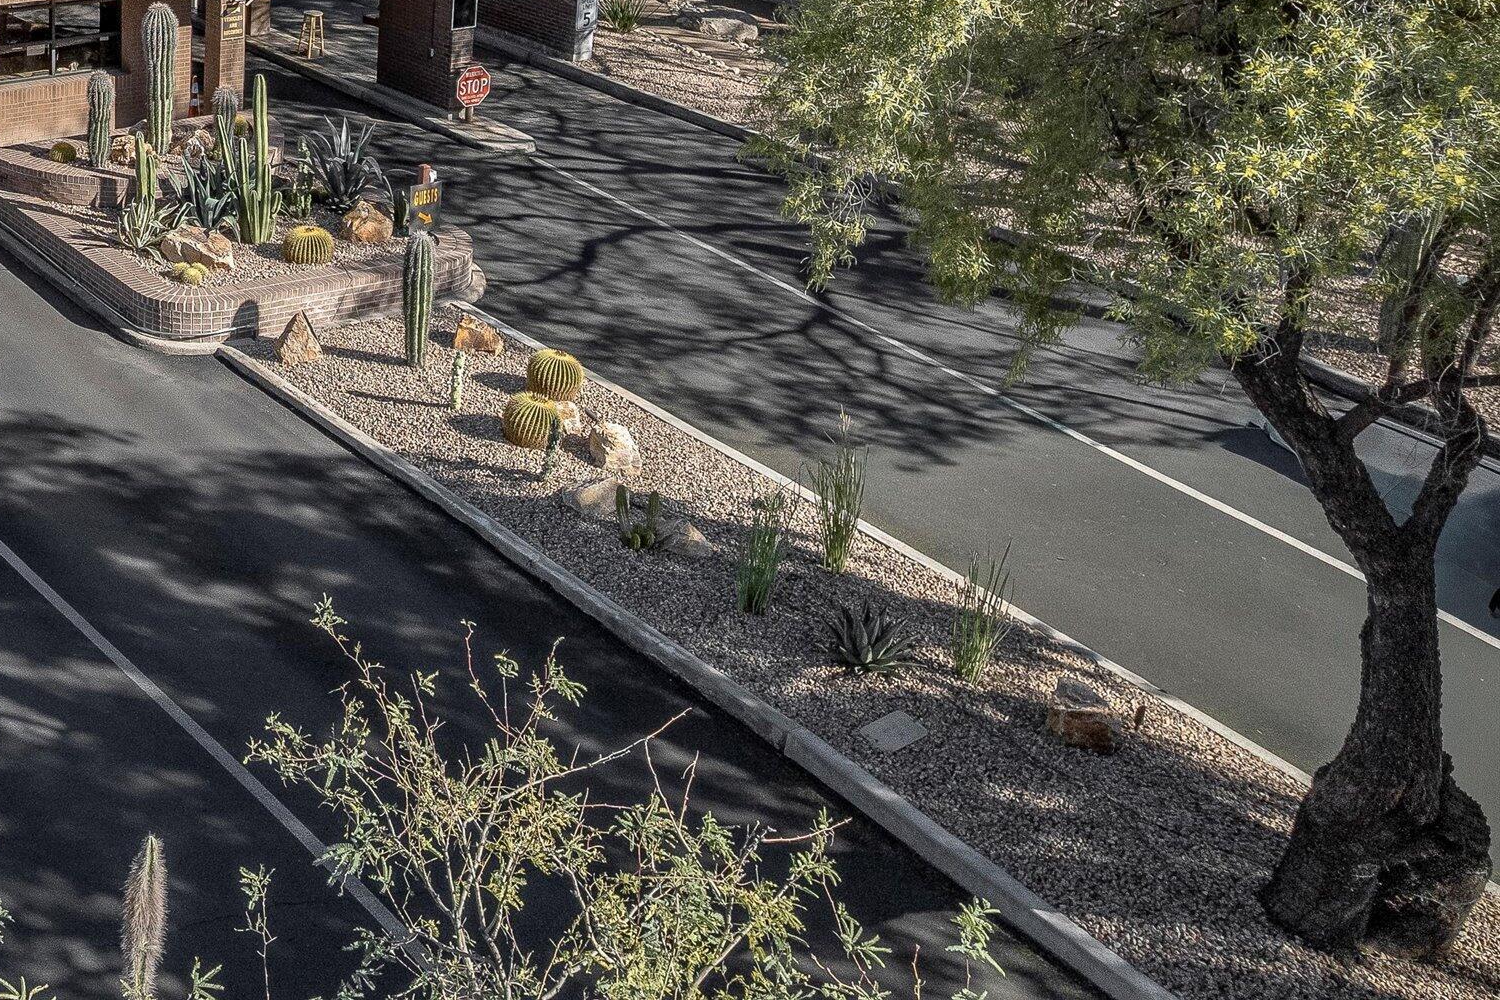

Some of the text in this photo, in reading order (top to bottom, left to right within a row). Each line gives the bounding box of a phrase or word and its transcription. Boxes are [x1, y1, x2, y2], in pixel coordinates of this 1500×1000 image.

[583, 12, 591, 26] 5
[460, 78, 488, 95] STOP
[414, 188, 438, 207] GUESTS
